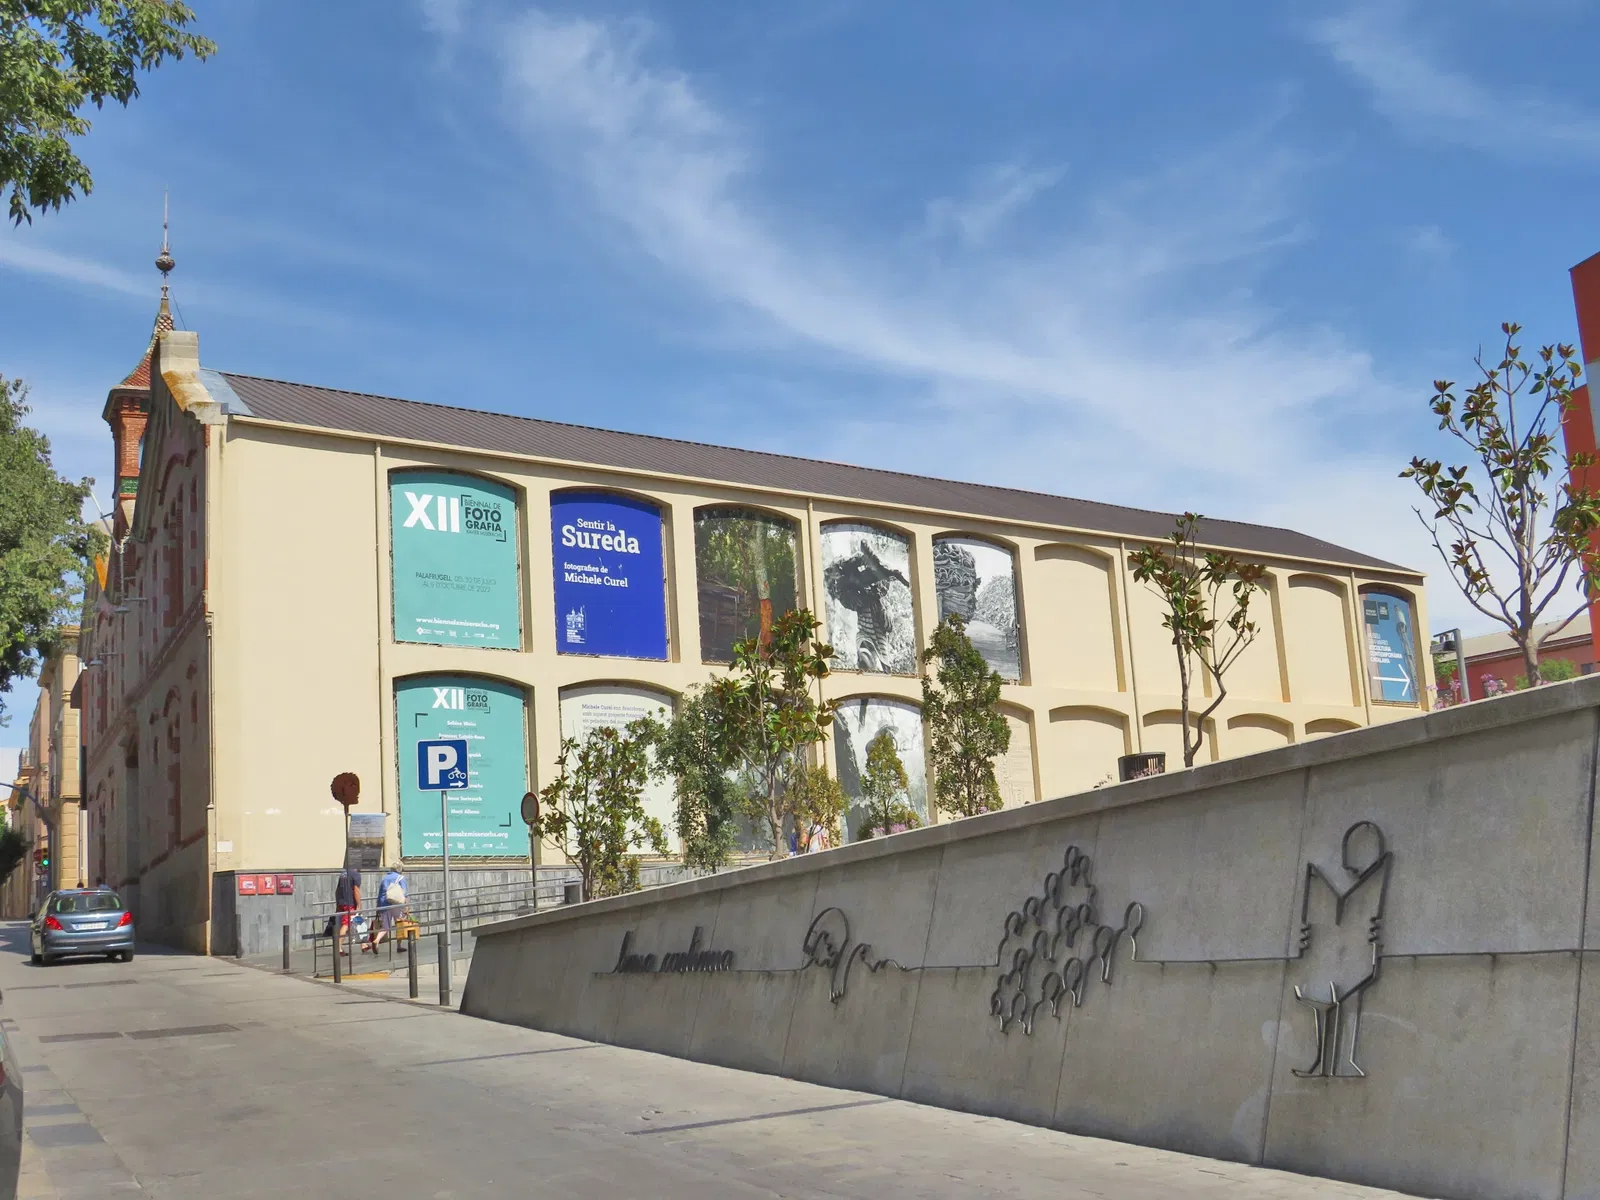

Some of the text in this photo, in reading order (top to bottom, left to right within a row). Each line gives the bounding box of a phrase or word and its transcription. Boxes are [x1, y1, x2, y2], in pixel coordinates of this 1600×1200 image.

[403, 491, 460, 533] XII
[493, 502, 502, 510] DE
[465, 507, 502, 522] FOTO
[465, 520, 502, 532] GRAFIA
[577, 518, 616, 532] Sentir la
[562, 524, 640, 554] Sureda
[564, 562, 608, 574] fotografies de
[416, 572, 452, 582] PALAFRUGELL
[565, 572, 628, 588] Michele Curel
[432, 688, 464, 710] XII
[466, 694, 488, 702] FOTO
[428, 745, 458, 784] P
